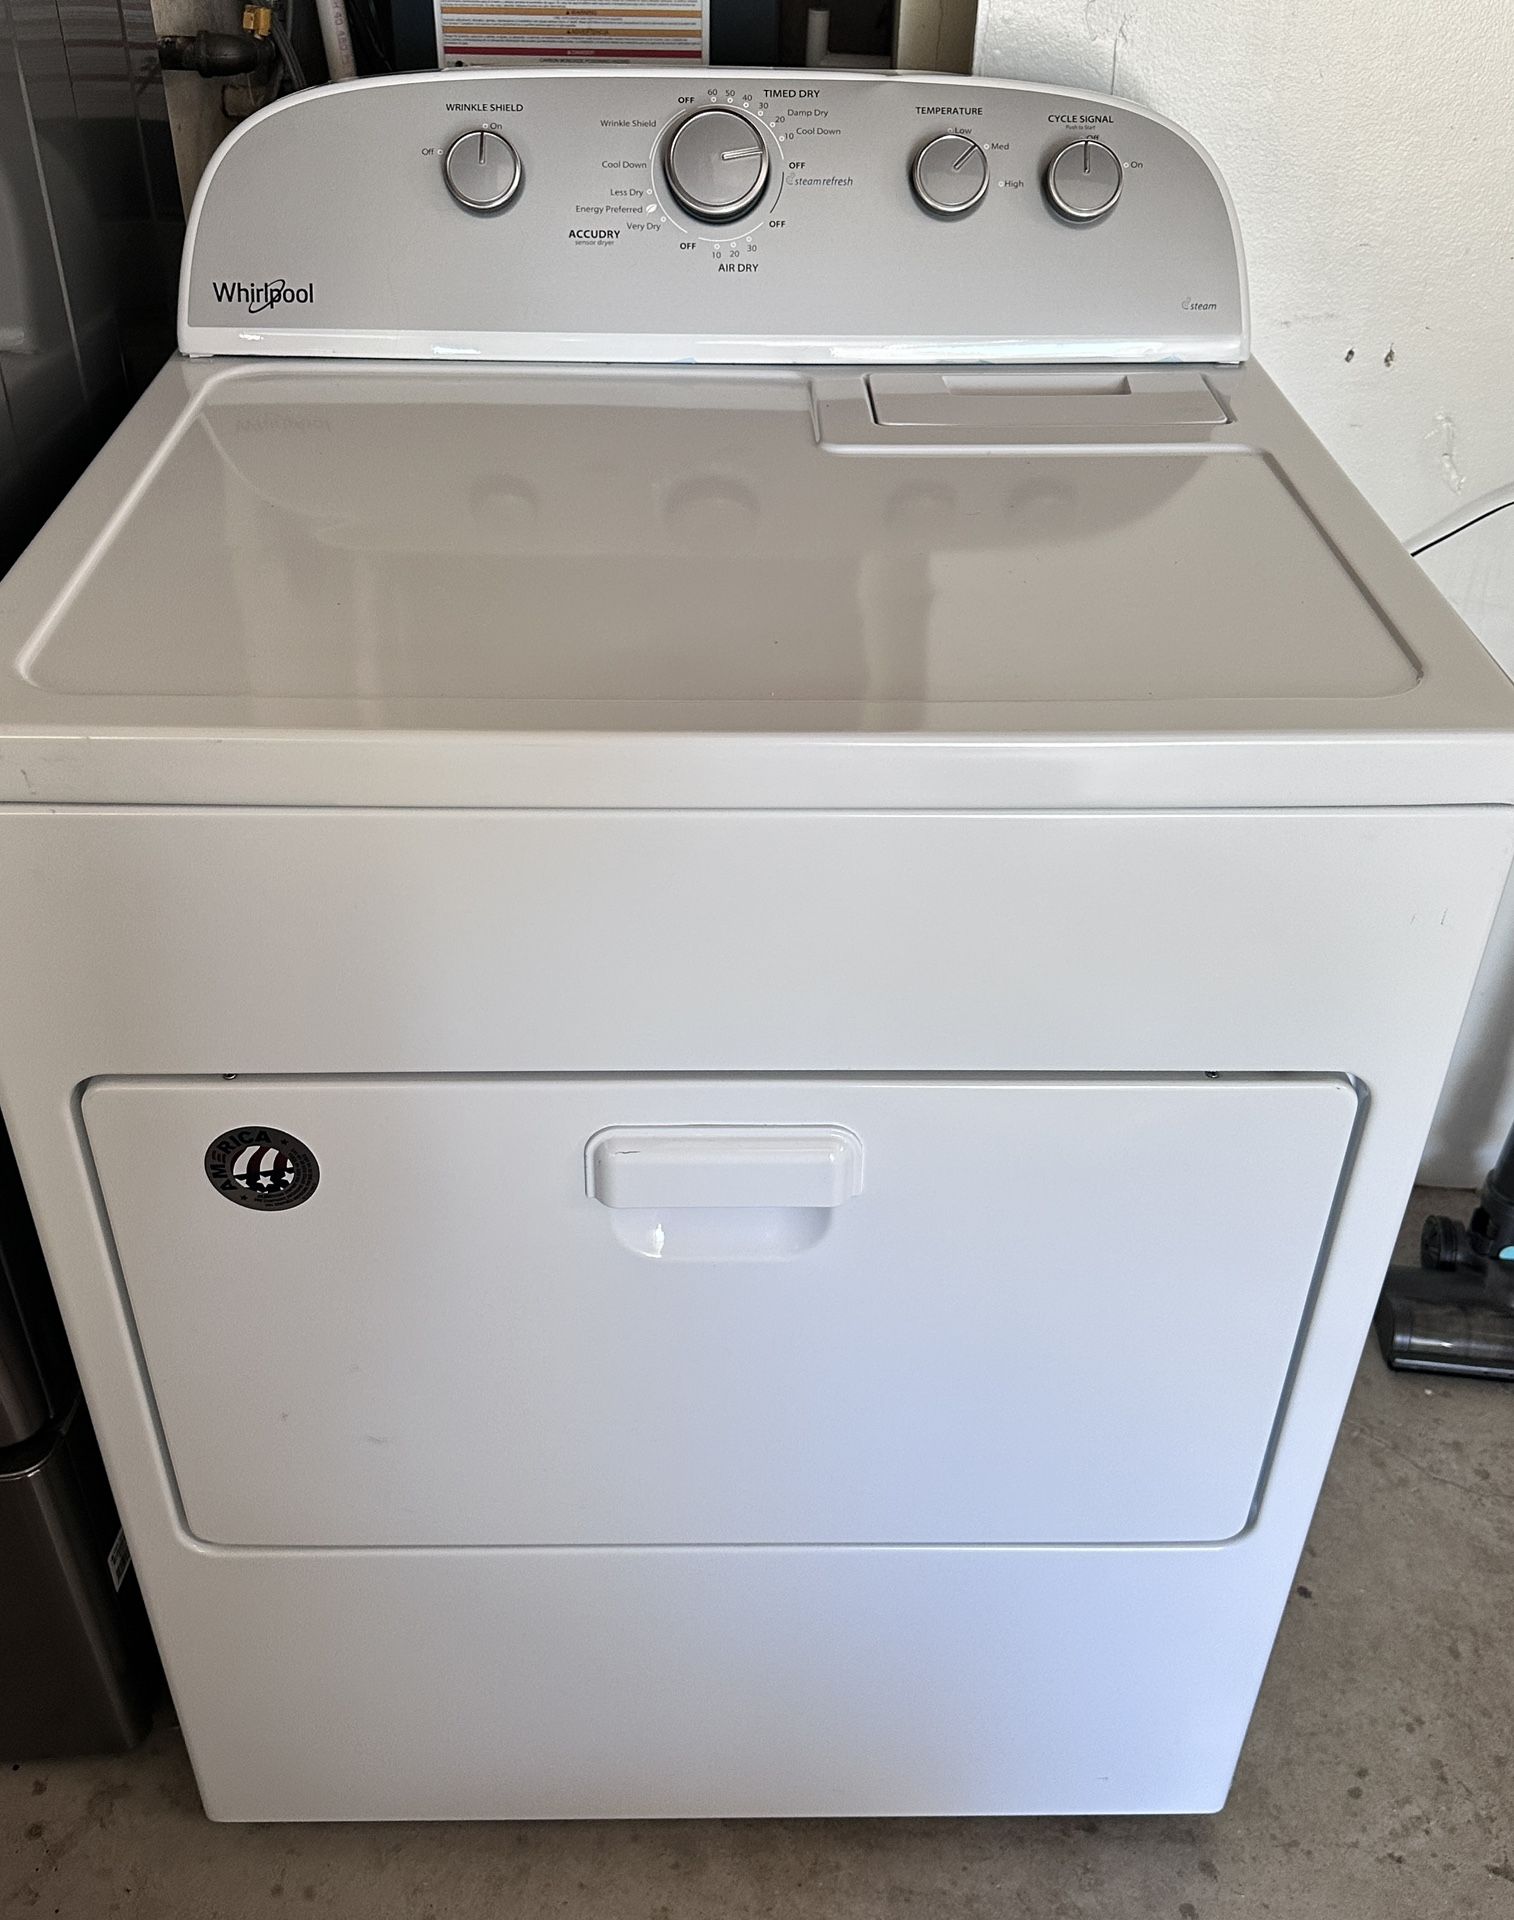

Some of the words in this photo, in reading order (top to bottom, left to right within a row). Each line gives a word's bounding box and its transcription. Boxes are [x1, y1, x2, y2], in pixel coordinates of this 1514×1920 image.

[764, 89, 797, 98] TIMED
[799, 90, 821, 98] DRY
[677, 96, 696, 104] OFF
[446, 103, 488, 112] WRINKLE
[490, 103, 524, 112] SHIELD
[759, 102, 769, 110] 30
[787, 109, 813, 118] Damp
[814, 109, 829, 118] Dry
[915, 106, 984, 116] TEMPERATURE
[1047, 114, 1078, 123] CYCLE
[1079, 115, 1115, 124] SIGNAL
[489, 122, 503, 130] On
[600, 120, 631, 128] Wrinkle
[632, 120, 657, 128] Shield
[796, 127, 816, 135] Cool
[784, 132, 795, 140] 10
[991, 143, 1010, 151] Med
[421, 148, 435, 156] Off
[601, 160, 621, 169] Cool
[622, 161, 647, 169] Down
[788, 162, 806, 170] OFF
[1130, 161, 1144, 169] On
[1004, 180, 1024, 189] High
[629, 189, 644, 198] Dry
[575, 205, 604, 215] Energy
[606, 205, 643, 214] Preferred
[626, 222, 648, 231] Very
[649, 222, 662, 231] Dry
[769, 220, 787, 228] OFF
[568, 229, 621, 239] ACCUDRY
[679, 242, 697, 250] OFF
[712, 251, 722, 259] 10
[730, 250, 740, 258] 20
[718, 263, 736, 272] AIR
[737, 263, 759, 272] DRY
[212, 280, 314, 311] Whirlpool
[1190, 302, 1217, 311] steam
[209, 1130, 272, 1191] AMERICA
